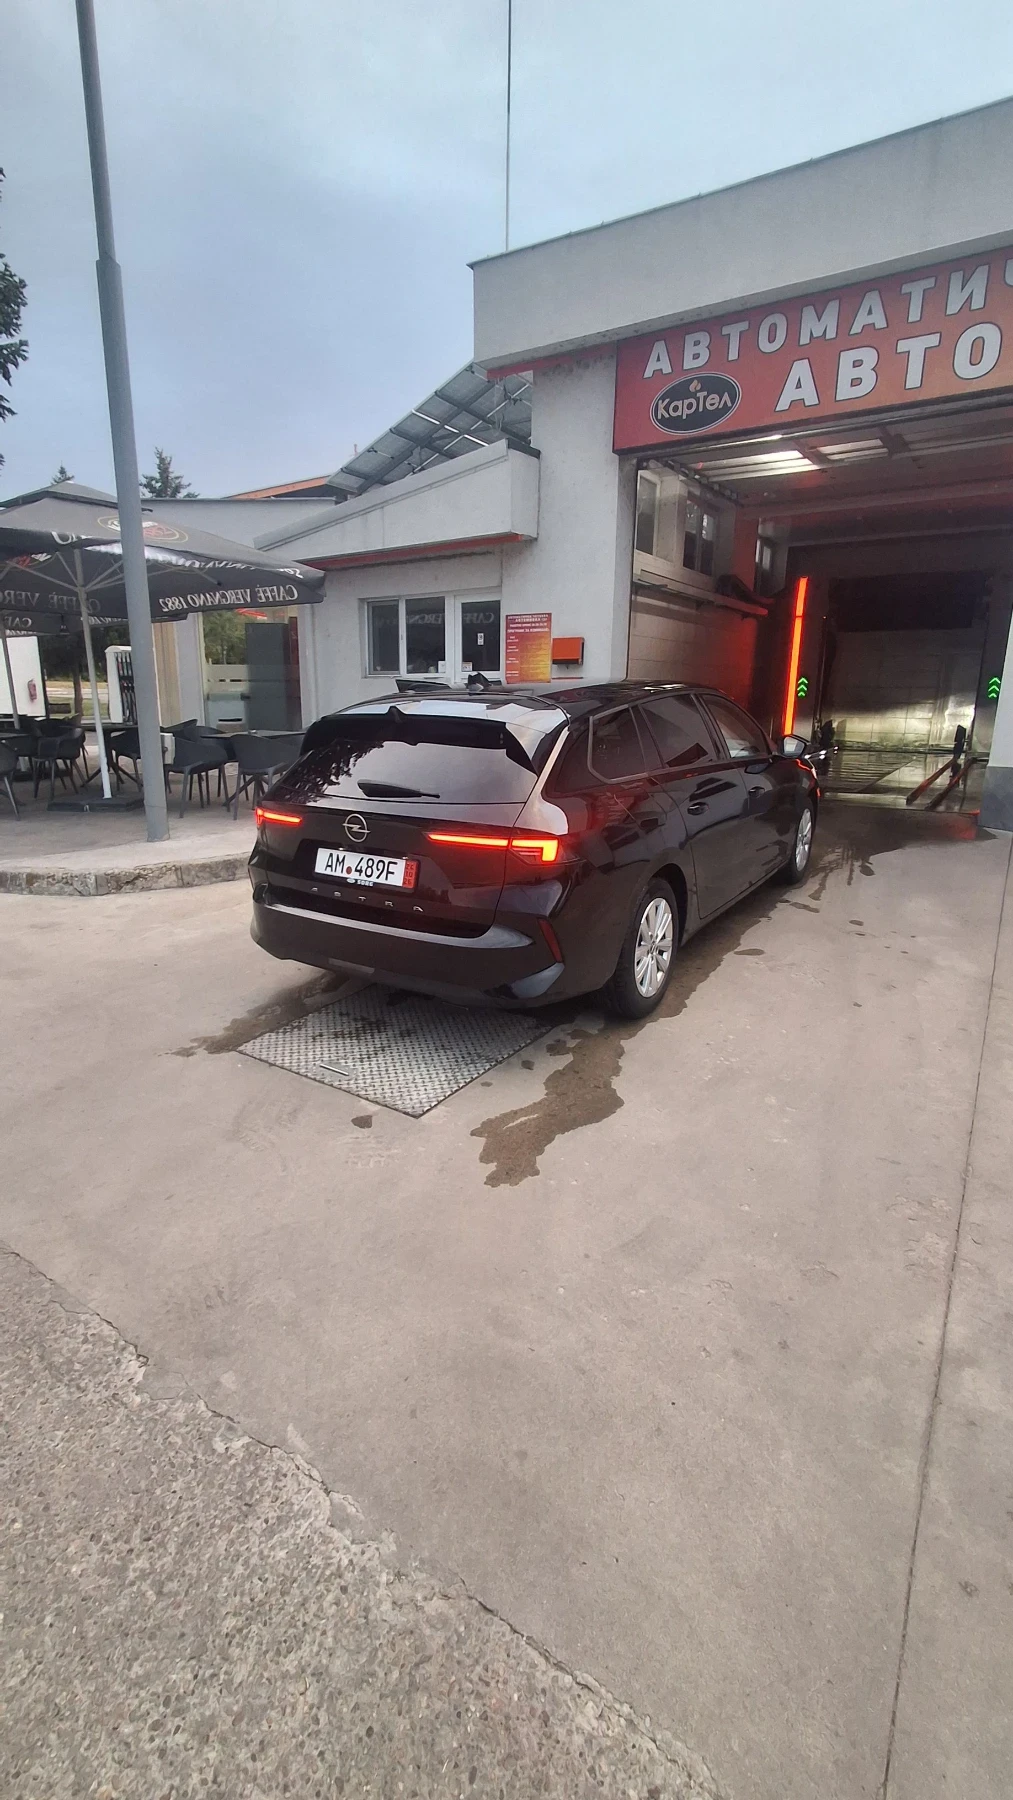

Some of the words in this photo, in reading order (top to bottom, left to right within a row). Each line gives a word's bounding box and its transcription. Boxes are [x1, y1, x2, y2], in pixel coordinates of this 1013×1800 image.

[642, 258, 1013, 379] АВТОМАТИ
[774, 321, 1003, 412] АВТО
[324, 853, 346, 874] AM
[354, 857, 398, 881] 489F
[310, 887, 424, 912] ASTRA
